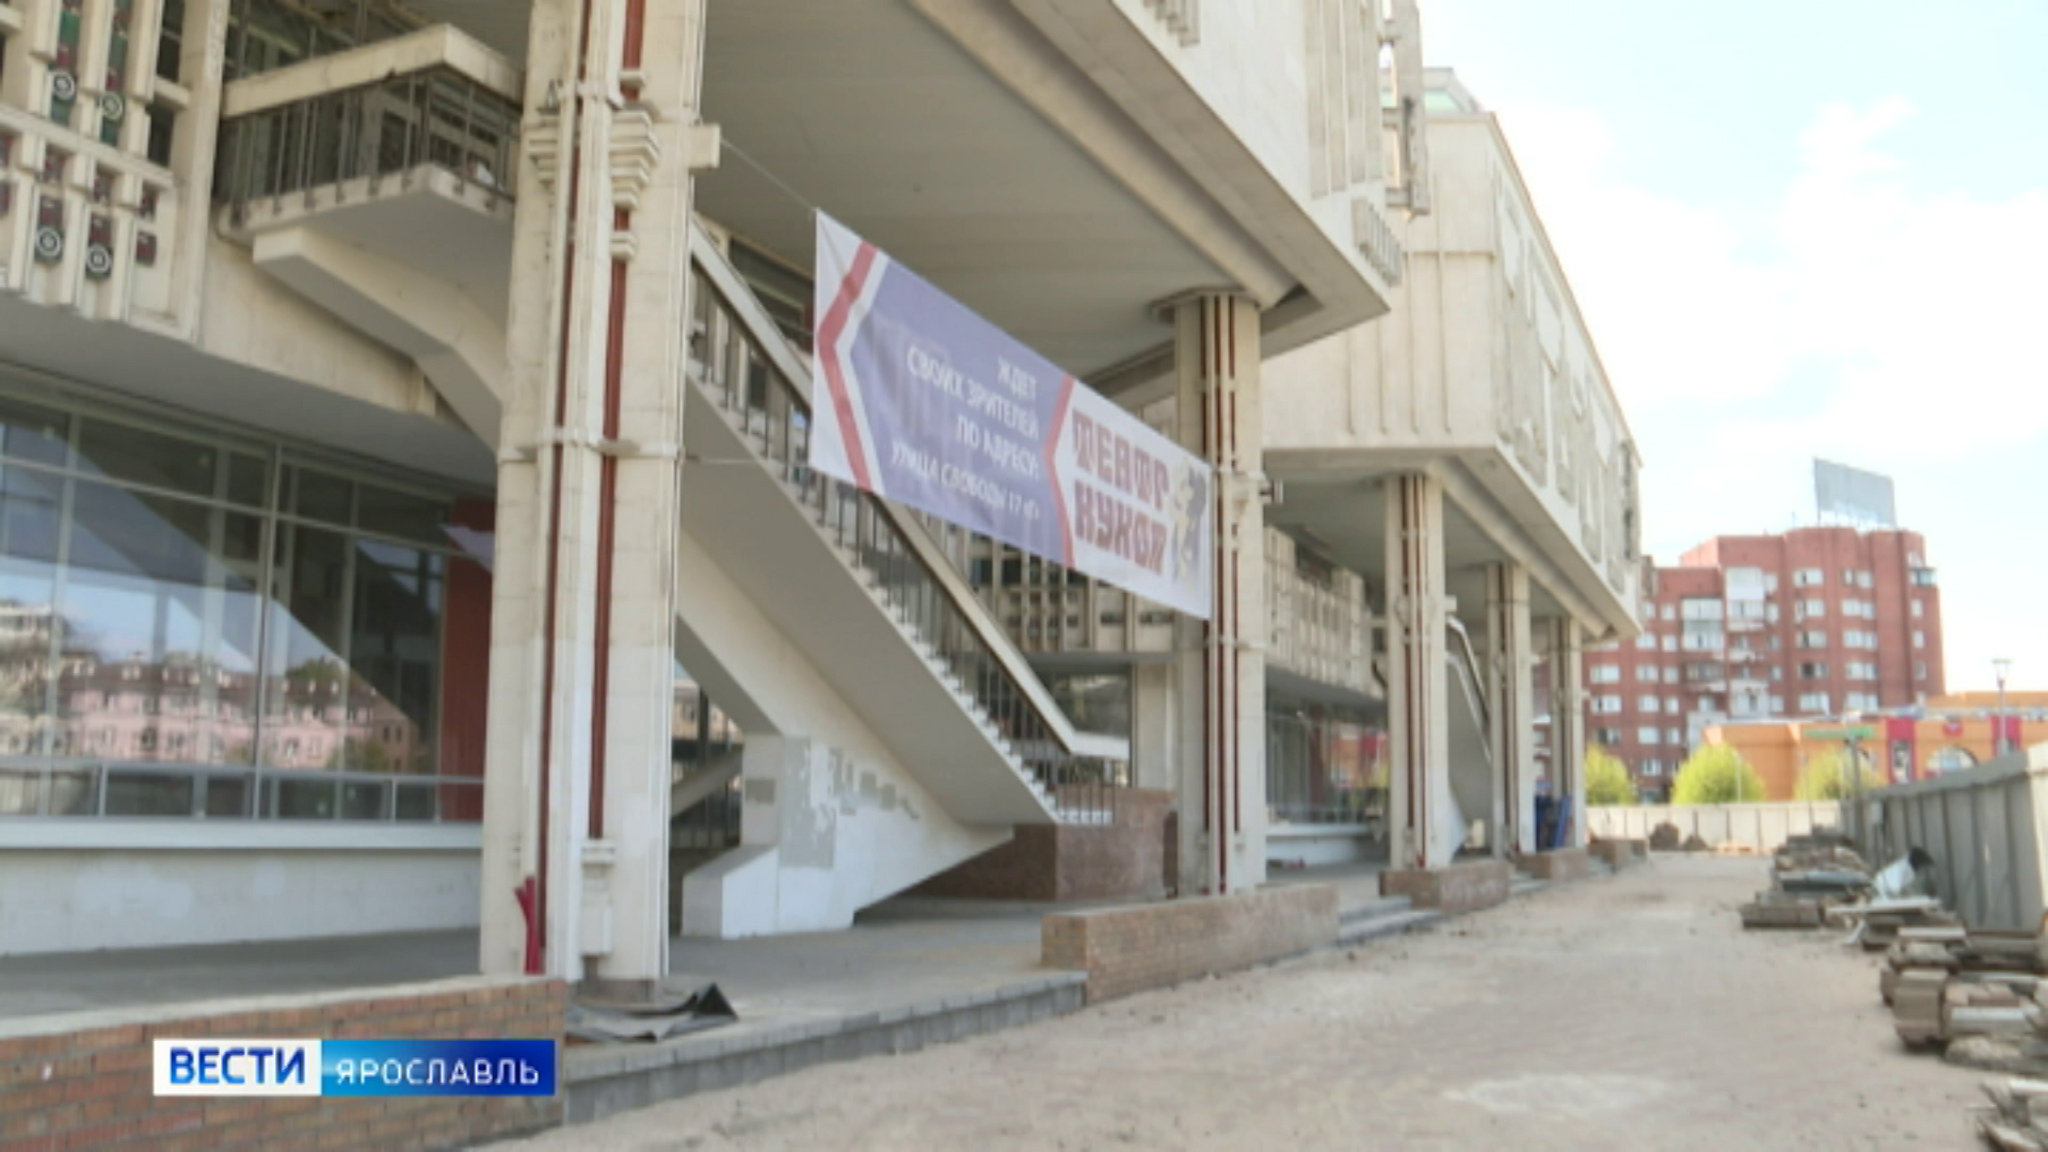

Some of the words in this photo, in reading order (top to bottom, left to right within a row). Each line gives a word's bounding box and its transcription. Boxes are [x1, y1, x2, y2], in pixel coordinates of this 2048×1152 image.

[906, 344, 965, 399] СВОИХ
[966, 377, 1040, 441] ЗРИТЕЛЕЙ
[997, 354, 1037, 401] ЖДЕТ
[956, 413, 980, 450] ПО
[1071, 408, 1170, 512] ТЕАТР
[891, 437, 940, 484] УЛИЦА
[941, 462, 1008, 509] СВОБОДЫ
[1008, 490, 1023, 517] 17
[1073, 478, 1169, 575] КУКОЛ
